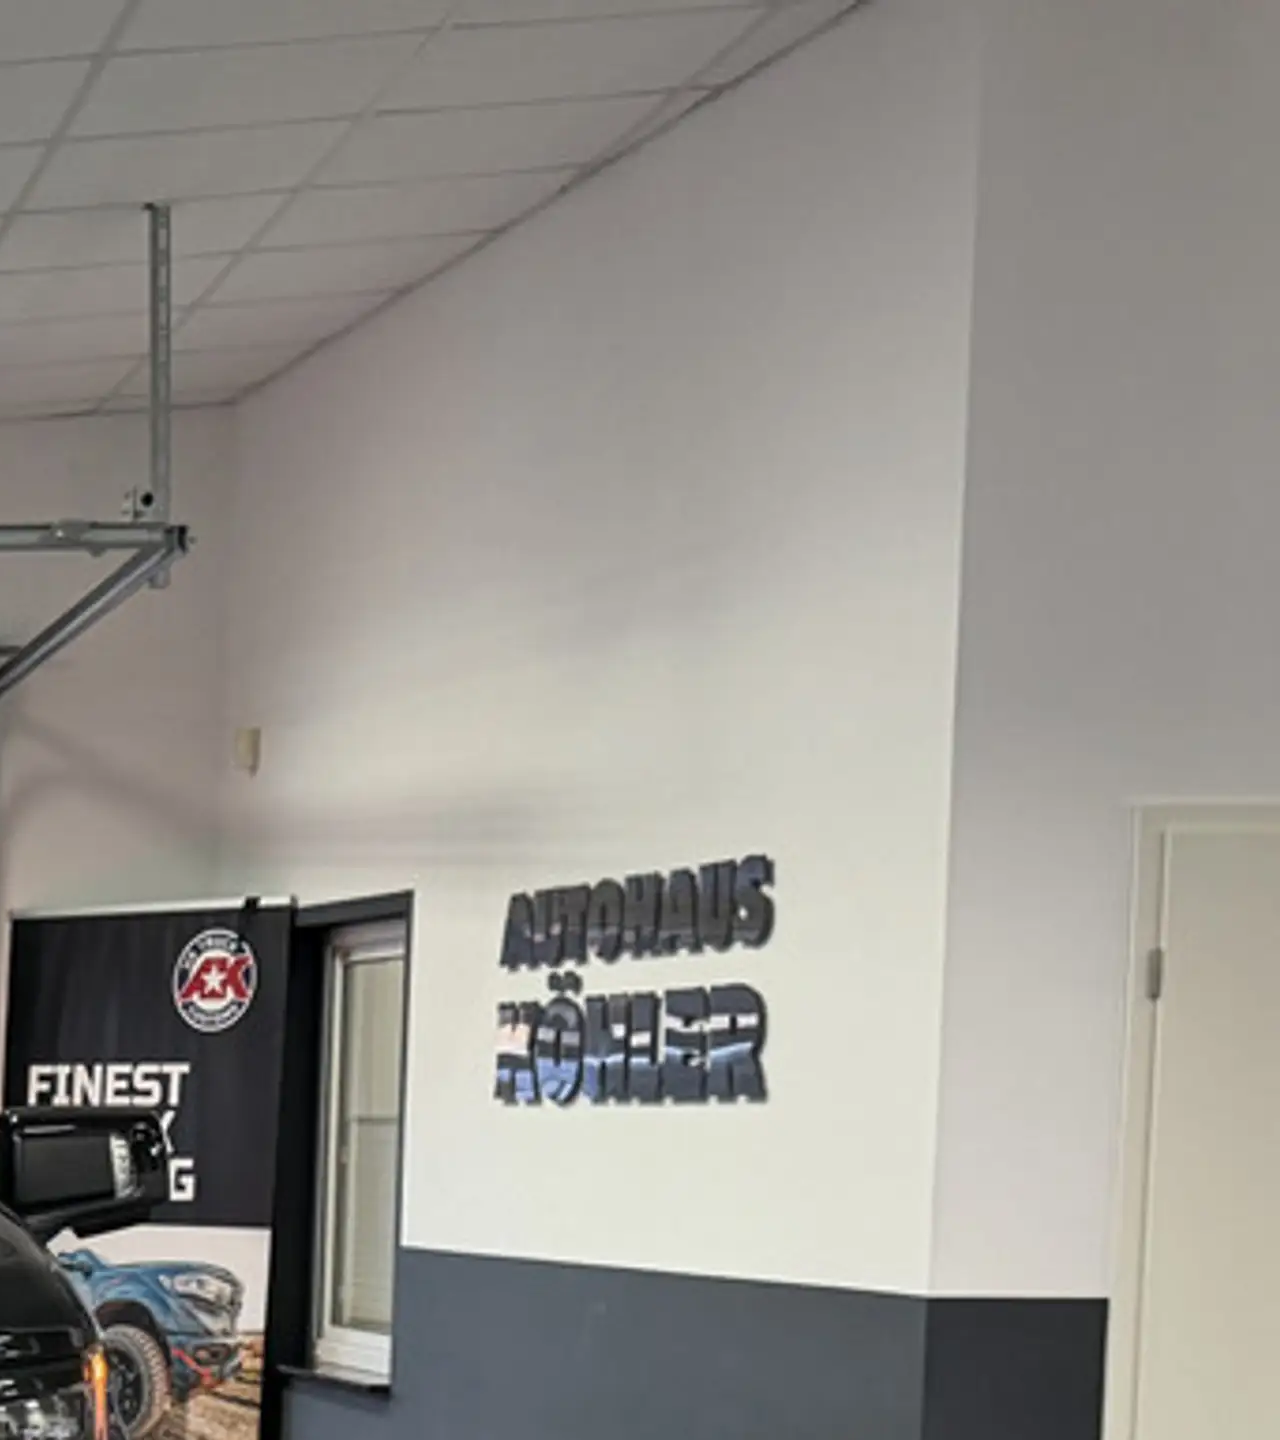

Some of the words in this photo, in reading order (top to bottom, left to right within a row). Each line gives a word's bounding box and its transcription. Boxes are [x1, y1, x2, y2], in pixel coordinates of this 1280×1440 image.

[499, 854, 775, 972] AUTOHAUS
[27, 1063, 191, 1107] FINEST
[494, 970, 769, 1107] KÖHLER
